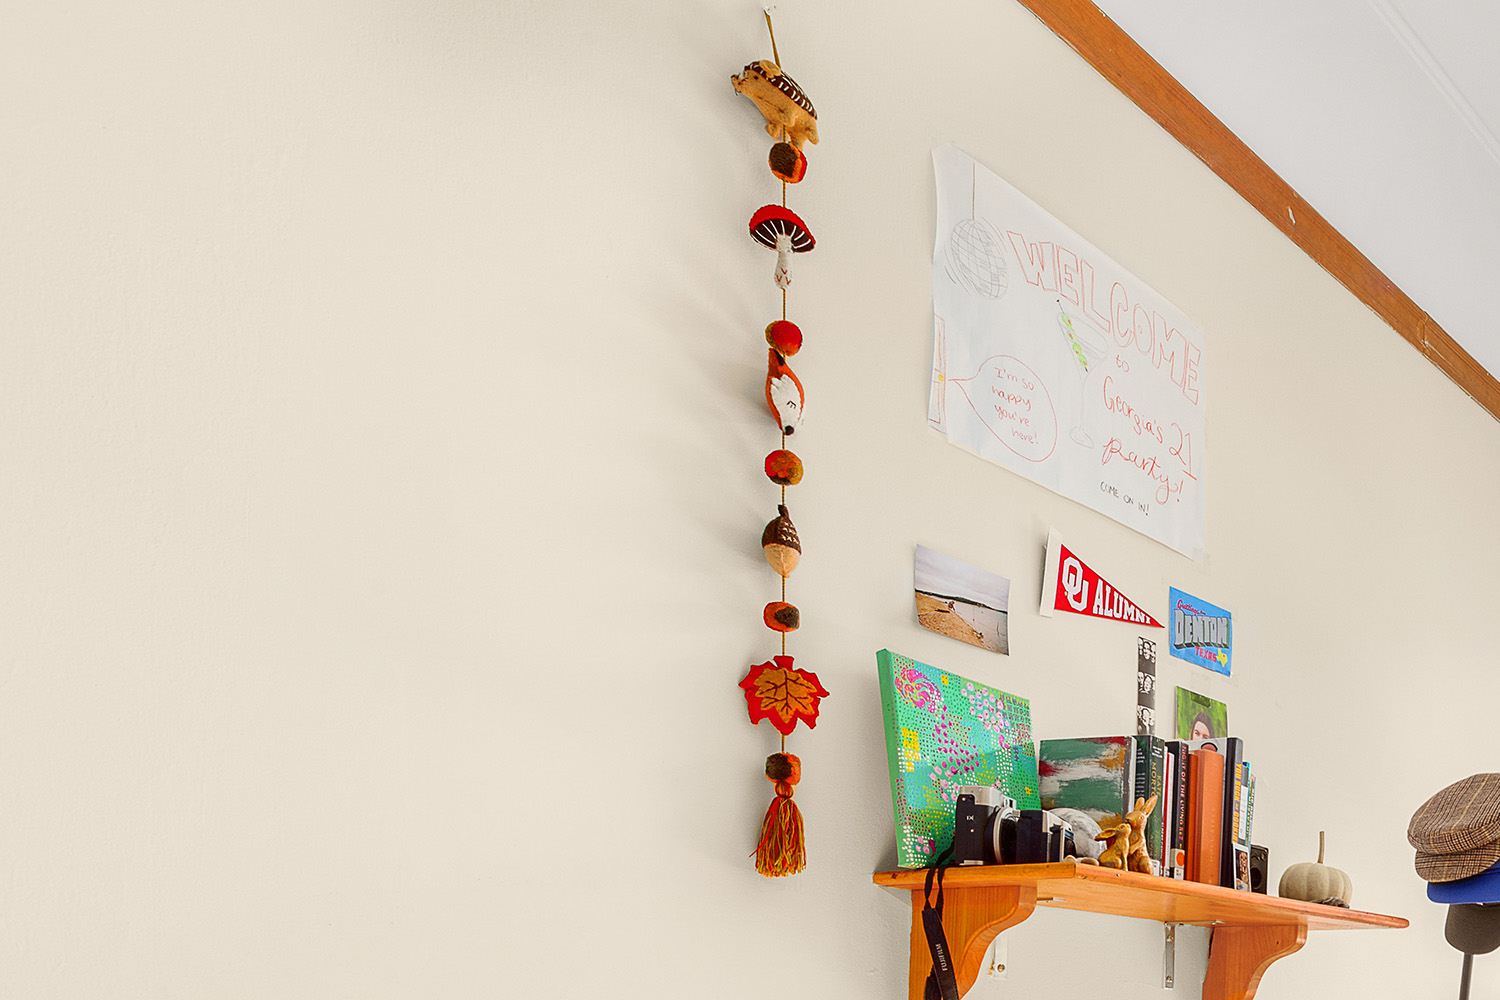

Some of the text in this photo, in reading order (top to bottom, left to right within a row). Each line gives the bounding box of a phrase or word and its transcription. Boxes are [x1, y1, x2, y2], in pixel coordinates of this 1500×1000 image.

[1006, 230, 1201, 406] WELCOME
[1115, 354, 1130, 373] to
[994, 366, 1035, 391] I'm so
[991, 385, 1032, 412] happy
[1103, 375, 1163, 444] Georgia's
[1100, 480, 1120, 499] COME
[1123, 494, 1135, 505] ON
[1062, 556, 1151, 625] OU ALUMNI
[1174, 608, 1229, 649] DENTON
[1195, 645, 1217, 663] TEXAS
[1180, 771, 1187, 782] OF
